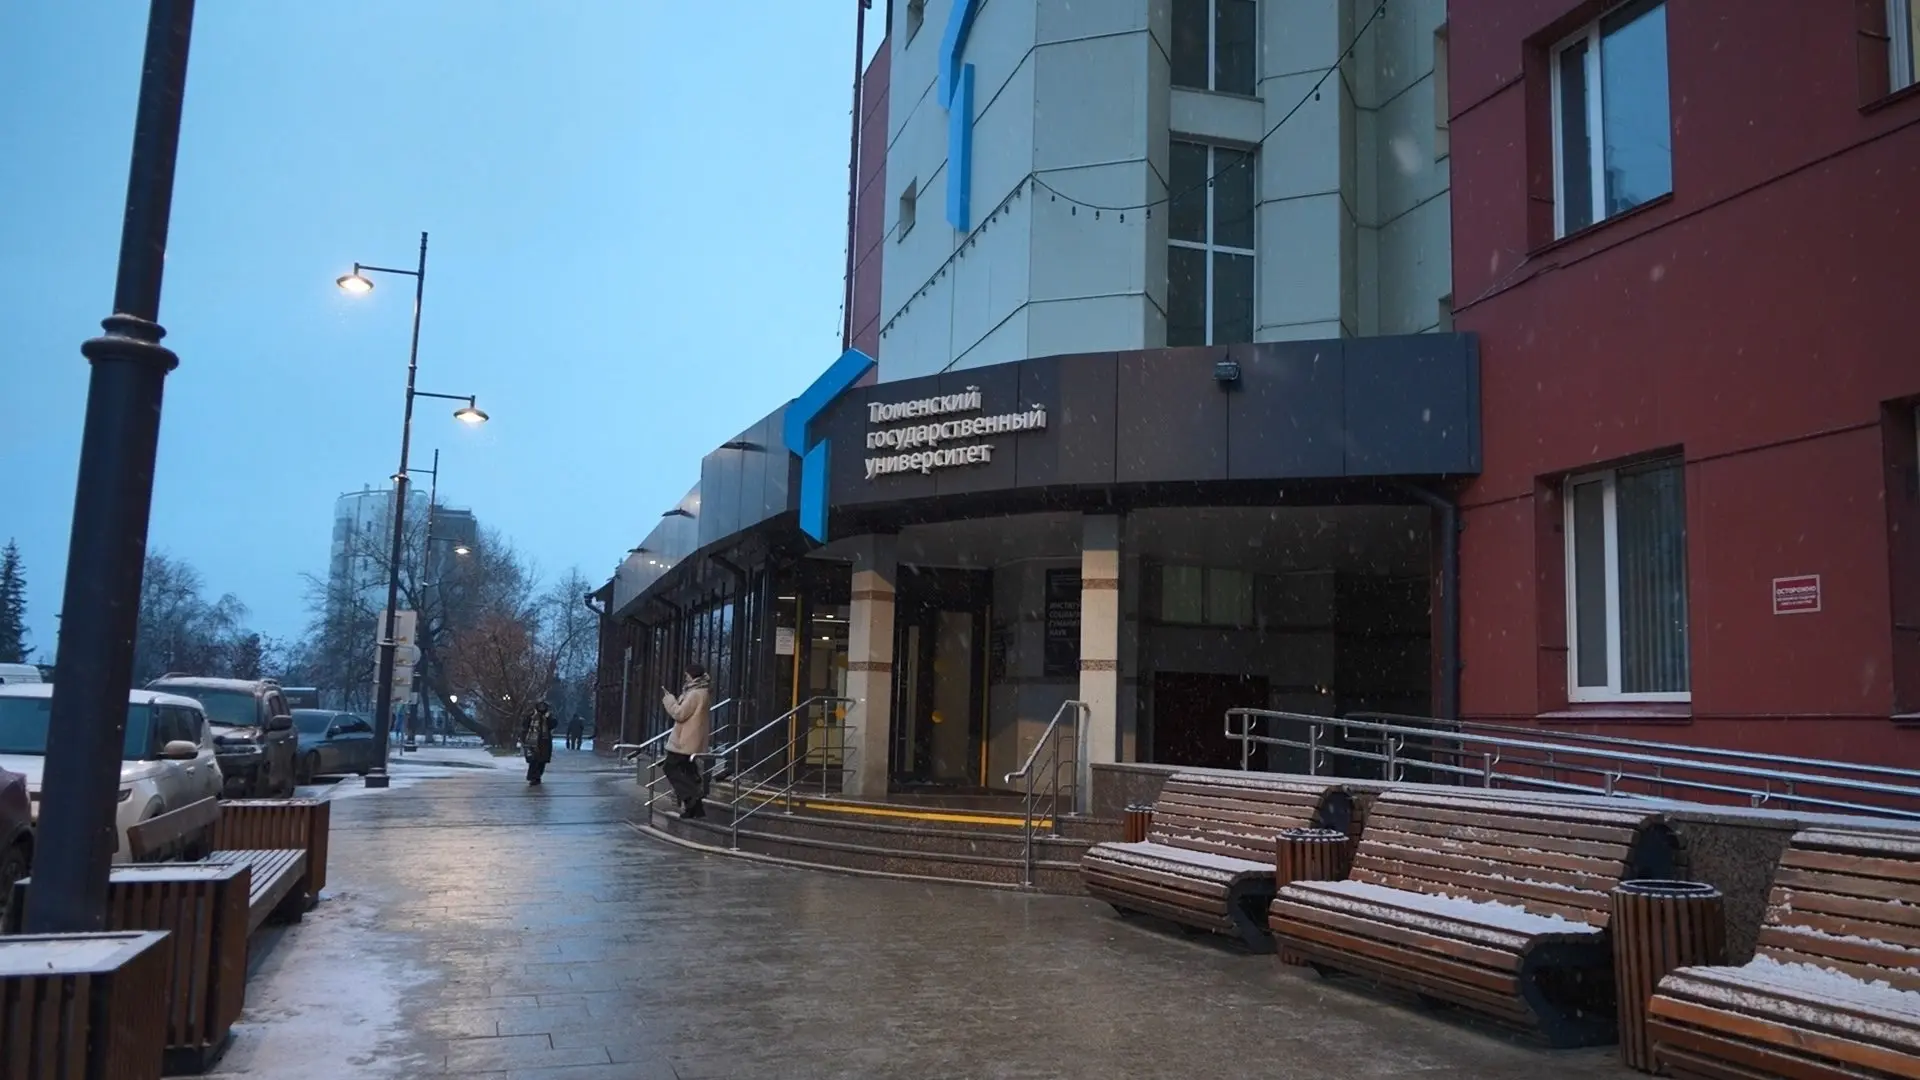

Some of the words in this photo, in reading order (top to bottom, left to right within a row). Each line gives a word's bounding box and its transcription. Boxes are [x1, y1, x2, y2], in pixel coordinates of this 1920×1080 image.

[867, 385, 982, 424] Тюменский
[866, 403, 1047, 450] государственный
[864, 444, 995, 480] университет
